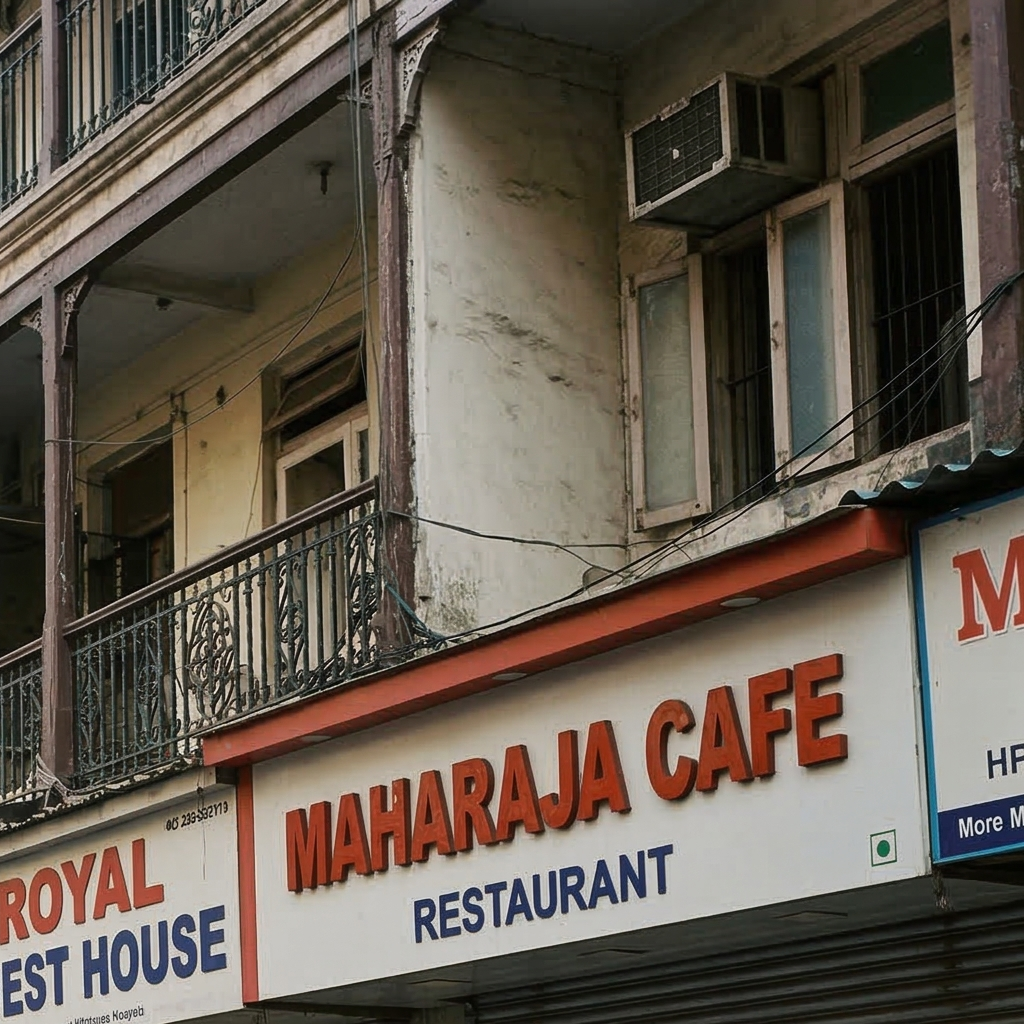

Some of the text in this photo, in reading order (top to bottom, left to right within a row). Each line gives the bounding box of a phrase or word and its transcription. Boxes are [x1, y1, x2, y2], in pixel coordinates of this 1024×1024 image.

[285, 653, 848, 893] MAHARAJA CAFE
[958, 815, 1003, 838] More
[414, 843, 673, 944] RESTAURANT
[82, 904, 227, 999] HOUSE
